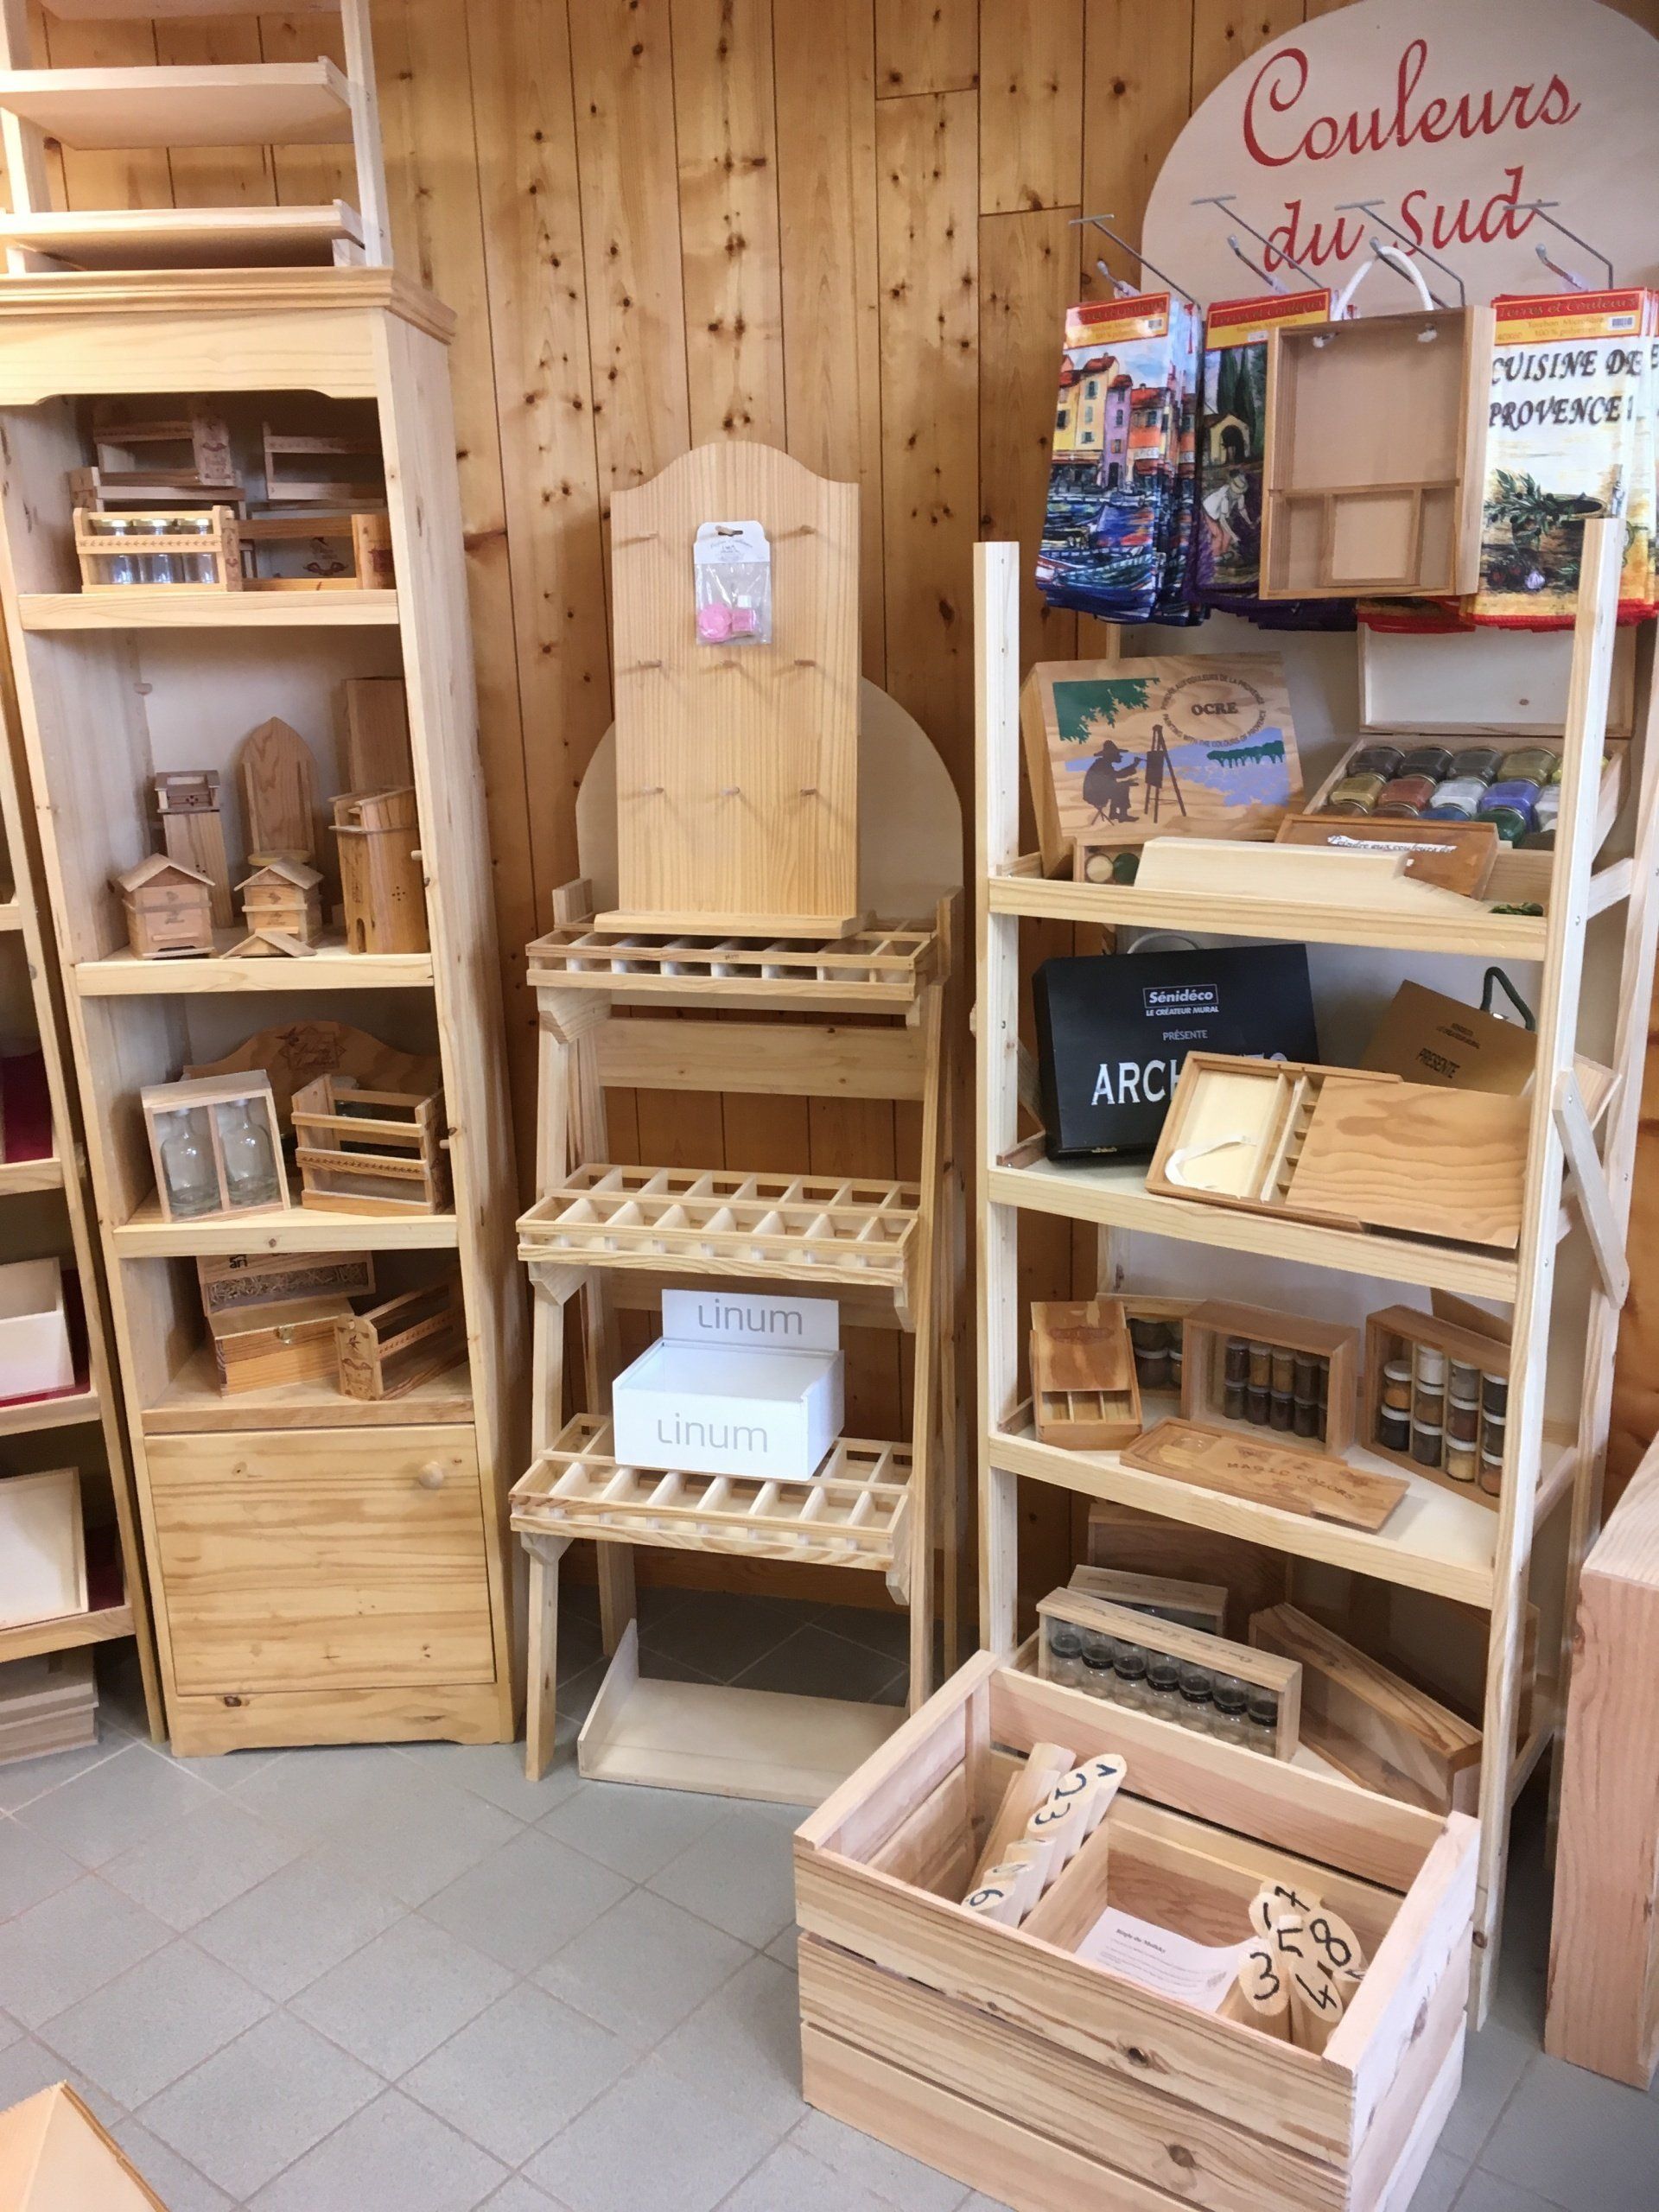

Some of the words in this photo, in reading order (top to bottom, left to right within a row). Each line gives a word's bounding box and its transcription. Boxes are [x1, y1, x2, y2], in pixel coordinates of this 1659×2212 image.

[1243, 39, 1581, 167] Couleurs
[1263, 200, 1364, 272] du
[1393, 165, 1539, 257] Sud
[1491, 350, 1598, 385] CUISINE
[1605, 348, 1643, 376] DE
[1489, 395, 1624, 431] PROVENCE
[1191, 702, 1238, 716] OCRE
[1146, 1008, 1154, 1017] LE
[1192, 1006, 1219, 1014] MURAL
[1148, 987, 1214, 1004] Sénidéco
[1162, 1029, 1208, 1042] PRÉSENTE
[697, 1298, 803, 1336] Linum
[657, 1412, 768, 1453] Linum
[1035, 1802, 1071, 1825] 3
[1274, 1886, 1311, 1911] 7
[1277, 1928, 1304, 1958] 5
[1309, 1918, 1352, 1967] 8
[1249, 1952, 1280, 2000] 3
[1295, 1974, 1338, 2010] 4
